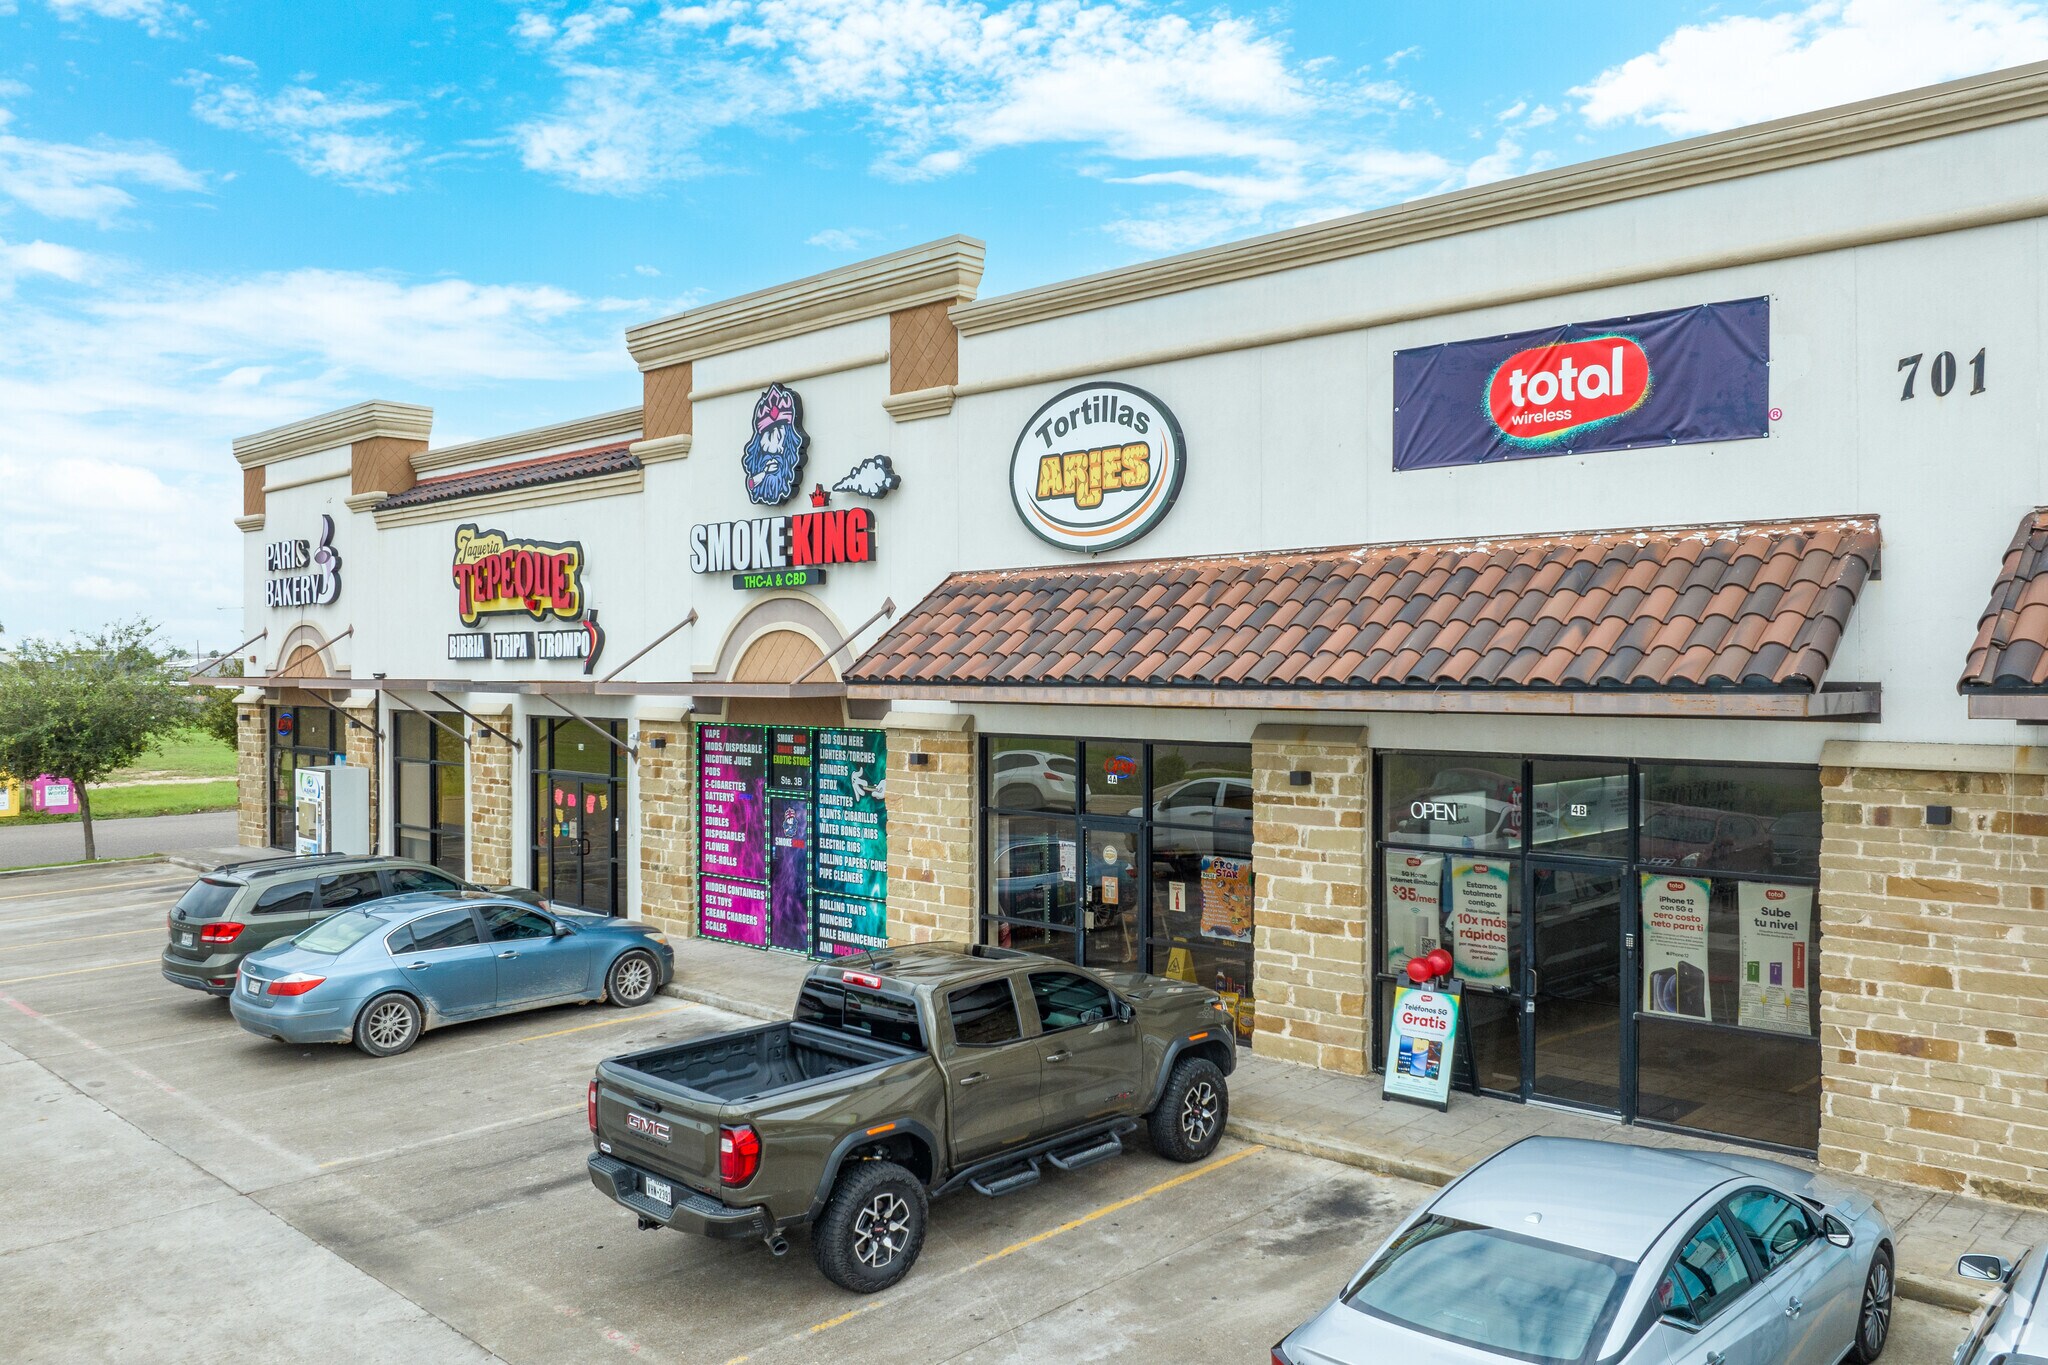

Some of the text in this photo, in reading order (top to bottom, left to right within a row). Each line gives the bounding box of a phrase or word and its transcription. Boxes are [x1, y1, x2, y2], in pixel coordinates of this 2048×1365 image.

[1509, 346, 1623, 407] total
[1897, 347, 1986, 401] 701
[1035, 395, 1150, 448] Tortillas
[1511, 409, 1572, 425] wireless
[690, 508, 871, 574] SMOKE KING
[265, 540, 308, 571] PARIS
[460, 536, 500, 563] Taqueria
[453, 549, 573, 614] TEPEQUE
[744, 572, 807, 588] THC-A & CBD
[265, 575, 320, 607] BAKERY
[449, 631, 591, 658] BIRRIA TRIPA TROMPO
[705, 729, 720, 738] VAPE
[777, 734, 794, 743] SMOKE
[820, 733, 863, 747] CBD SOLD HERE
[705, 742, 762, 753] MODS/DISPOSABLE
[705, 754, 752, 766] NICOTINE JUICE
[773, 754, 810, 767] EXOTIC STORE
[820, 749, 875, 763] LIGHTERS/TORCHES
[705, 767, 720, 776] PODS
[820, 763, 848, 776] GRINDERS
[705, 779, 746, 791] E-CIGARETTES
[780, 776, 803, 786] Ste. 3B
[820, 779, 837, 790] DETOX
[1107, 775, 1118, 784] 4A
[705, 791, 735, 802] BATTERYS
[820, 793, 853, 807] CIGARETTES
[820, 808, 878, 824] BLUNTS/CIGARILLOS
[1410, 801, 1457, 821] OPEN
[1572, 805, 1586, 816] 4B
[705, 816, 729, 827] EDIBLES
[705, 829, 745, 842] DISPOSABLES
[820, 823, 839, 835] WATER
[705, 841, 729, 852] FLOWER
[820, 838, 860, 853] ELECTRIC RIGS
[820, 853, 843, 866] ROLLING
[820, 868, 863, 884] PIPE CLEANERS
[1466, 881, 1498, 890] Estamos
[728, 885, 765, 900] CONTAINERS
[1462, 889, 1502, 899] totalmente
[705, 894, 732, 907] SEX TOYS
[1468, 899, 1497, 908] contigo.
[1659, 896, 1685, 905] iPhone
[820, 899, 866, 916] ROLLING TRAYS
[1761, 906, 1791, 918] Sube
[706, 907, 758, 926] CREAM CHARGERS
[820, 913, 852, 928] MUNCHIES
[1457, 913, 1507, 928] 10x más
[1653, 912, 1701, 923] cero costo
[705, 920, 727, 933] SCALES
[1650, 920, 1671, 928] neto
[1697, 924, 1703, 932] ti
[1754, 917, 1798, 930] tu nivel
[820, 927, 836, 939] MALE
[1460, 927, 1506, 942] rápidos
[819, 941, 833, 953] AND
[1402, 1012, 1447, 1030] Gratis
[626, 1112, 671, 1142] GMC
